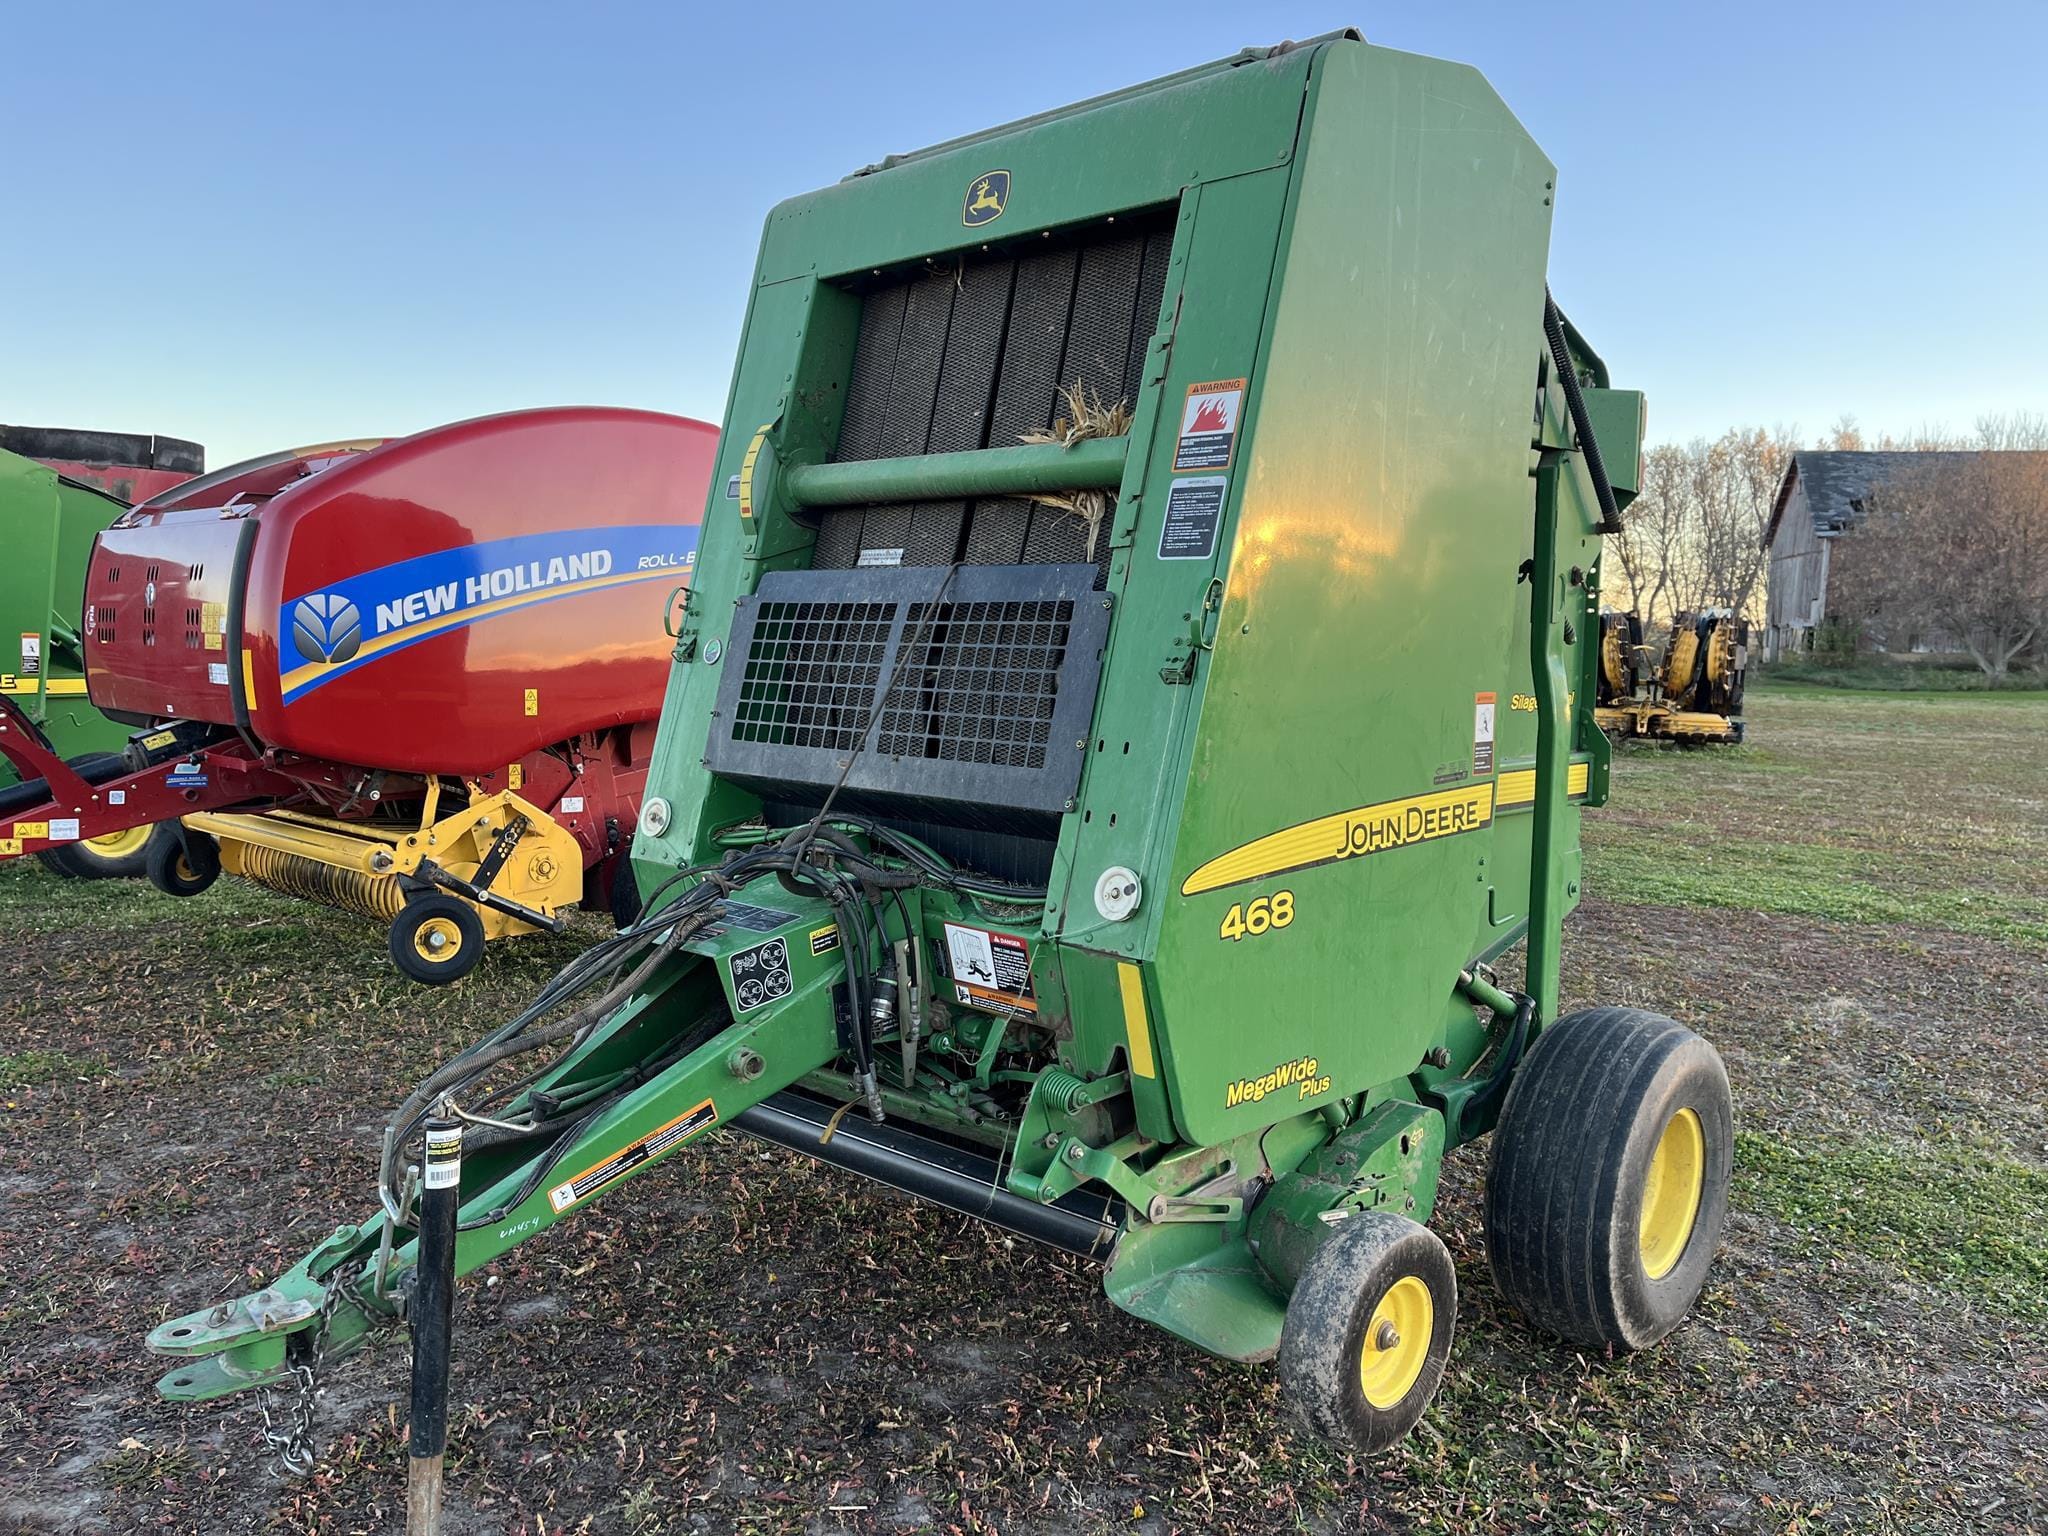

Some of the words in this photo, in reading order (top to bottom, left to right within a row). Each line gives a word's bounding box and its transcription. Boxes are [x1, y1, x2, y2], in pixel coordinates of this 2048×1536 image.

[1199, 380, 1240, 393] WARNING
[638, 551, 697, 570] ROLL-B
[376, 582, 459, 633] NEW
[466, 549, 612, 605] HOLLAND
[1337, 815, 1401, 855] JOHN
[1406, 800, 1479, 837] DEERE
[1220, 889, 1295, 942] 468
[1226, 1055, 1319, 1109] MegaWide
[1298, 1075, 1332, 1102] Plus
